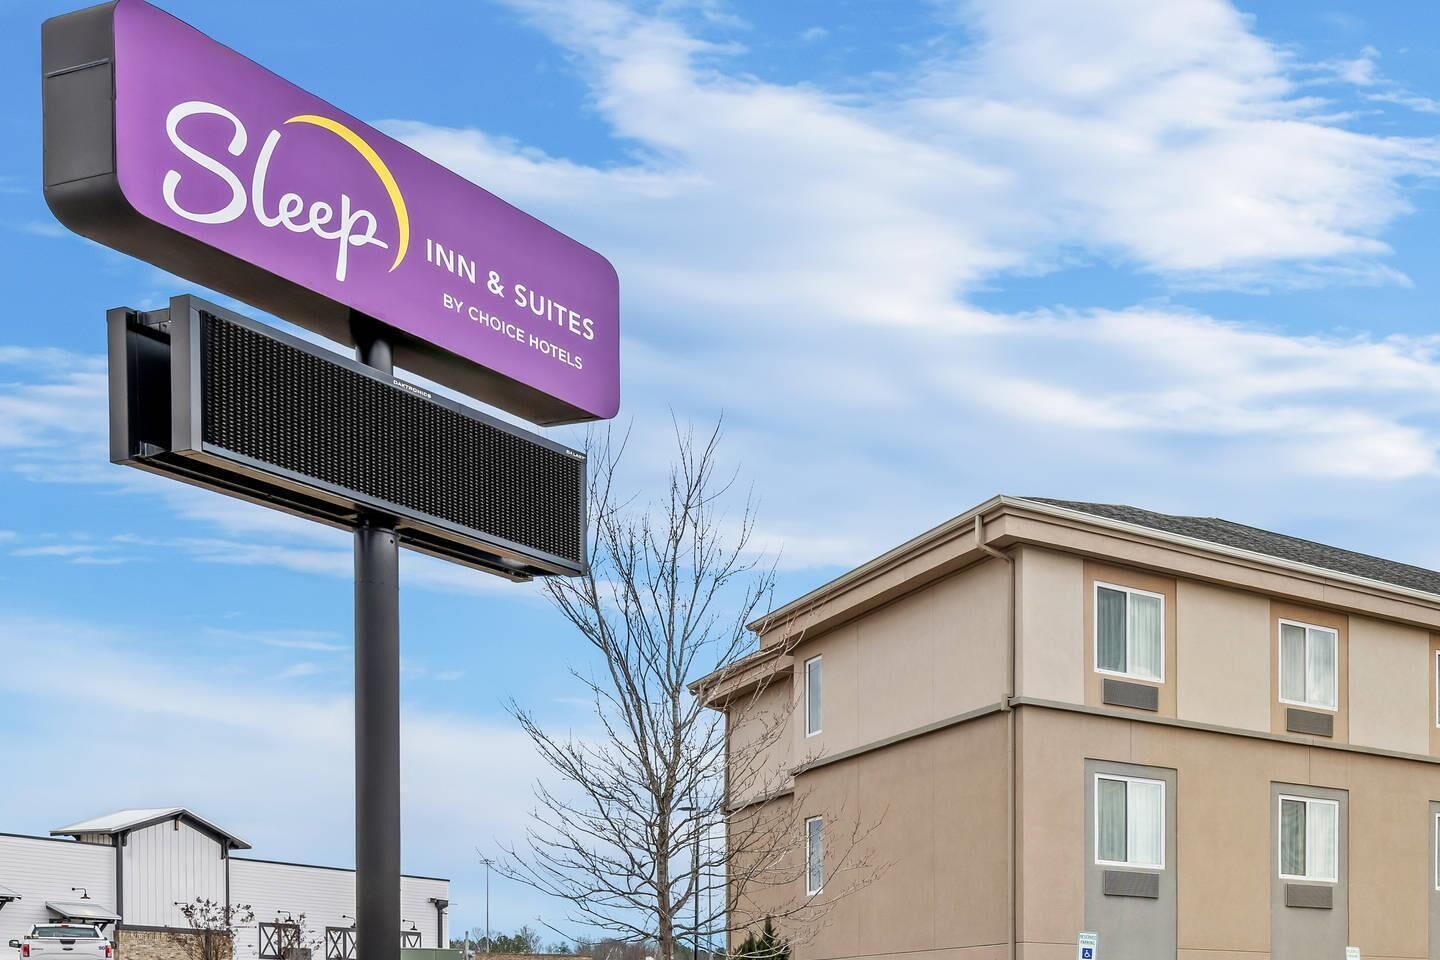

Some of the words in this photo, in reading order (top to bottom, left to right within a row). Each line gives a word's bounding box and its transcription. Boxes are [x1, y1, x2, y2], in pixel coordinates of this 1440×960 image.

[163, 101, 388, 282] Sleep
[426, 239, 476, 284] INN
[487, 270, 505, 298] &
[514, 284, 594, 340] SUITES
[443, 293, 464, 313] BY
[468, 306, 525, 343] CHOICE
[529, 334, 583, 370] HOTELS
